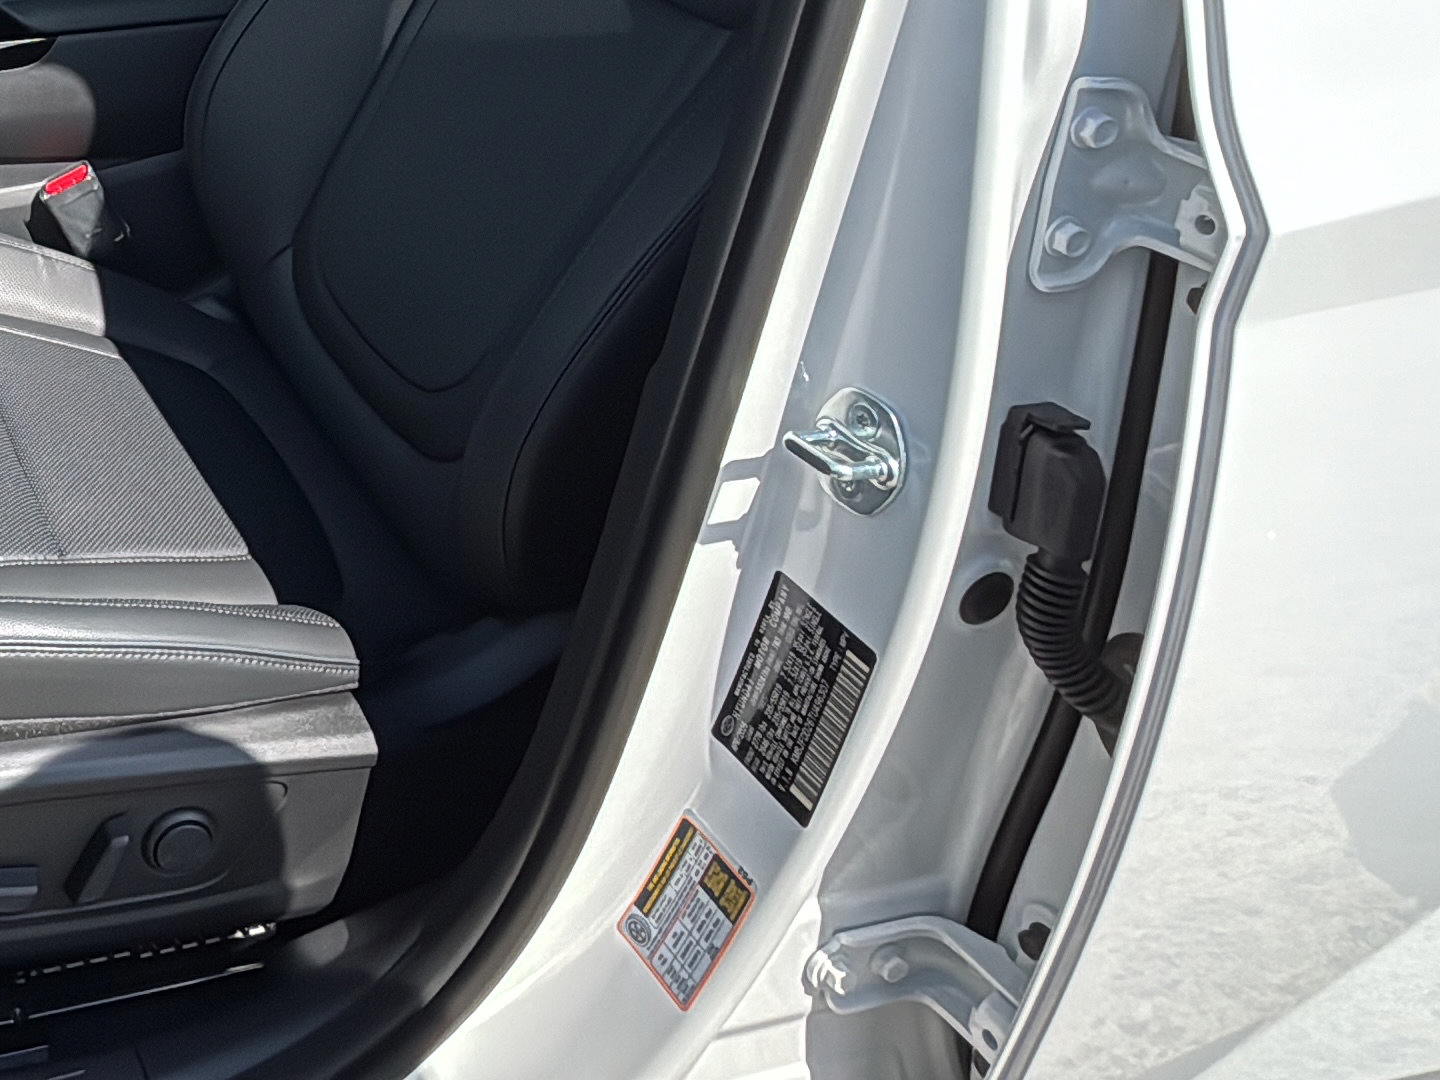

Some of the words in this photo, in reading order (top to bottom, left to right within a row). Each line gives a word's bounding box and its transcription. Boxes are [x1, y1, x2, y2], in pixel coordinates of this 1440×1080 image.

[732, 678, 754, 721] HYUNDAI
[754, 636, 770, 669] MOTOR
[767, 584, 789, 627] COMPANY
